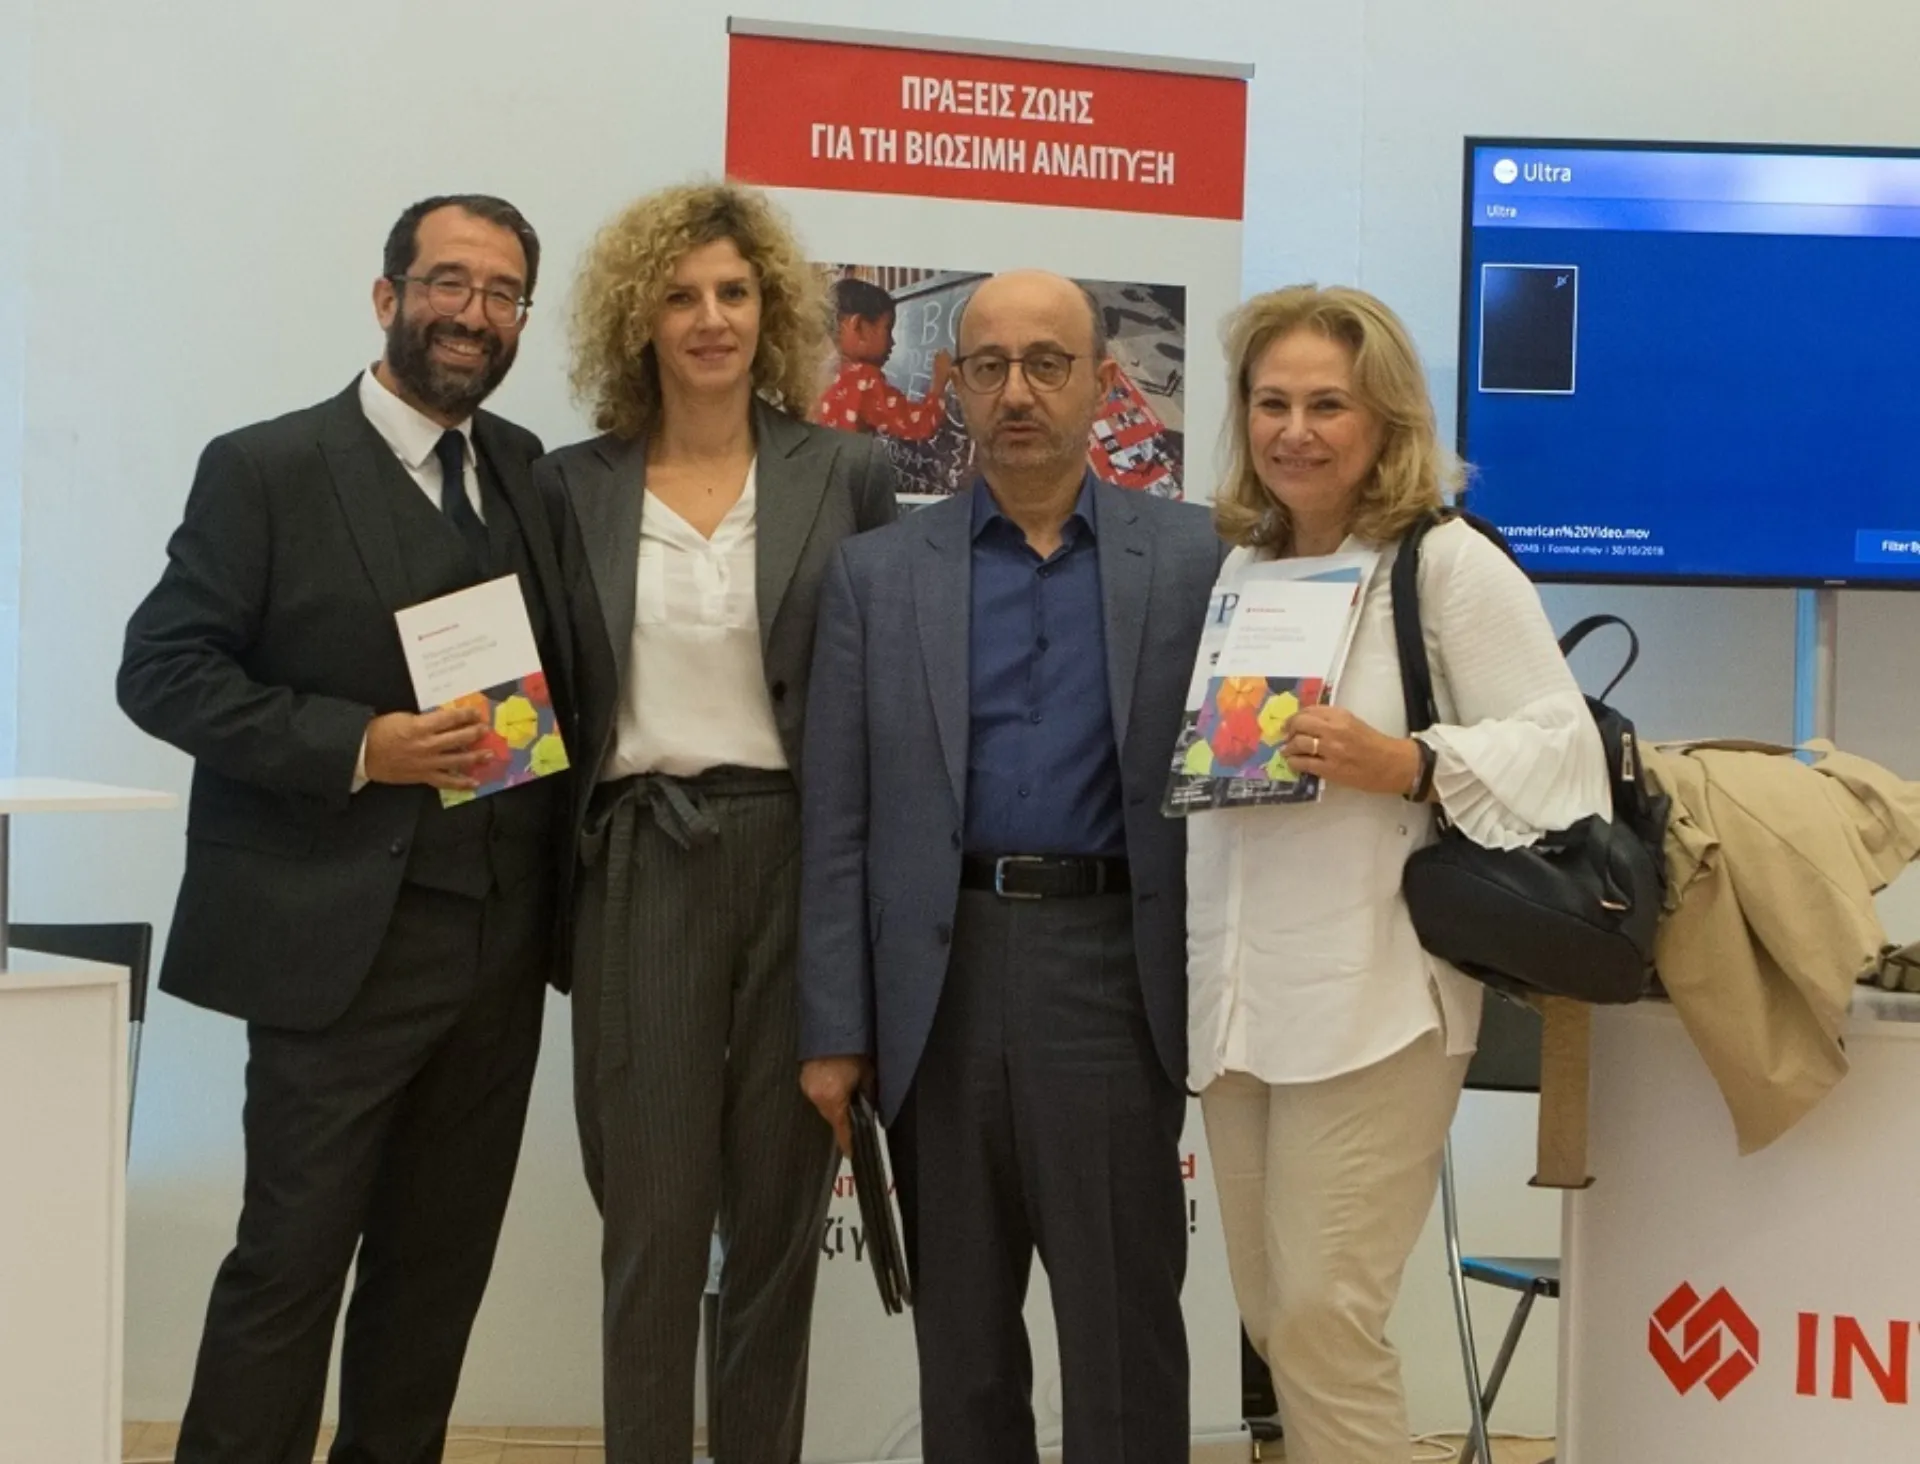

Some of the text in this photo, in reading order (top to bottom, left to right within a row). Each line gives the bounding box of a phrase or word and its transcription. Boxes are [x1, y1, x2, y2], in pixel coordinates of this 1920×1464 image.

[901, 75, 1094, 125] ΠΡΑΞΕΙΣ ΖΩΗΣ
[811, 122, 1175, 185] ΓΙΑ ΤΗ ΒΙΩΣΙΜΗ ΑΝΑΠΤΥΞΗ
[1523, 162, 1572, 183] Ultra
[1486, 204, 1518, 218] Ultra
[1796, 1311, 1920, 1405] IN
